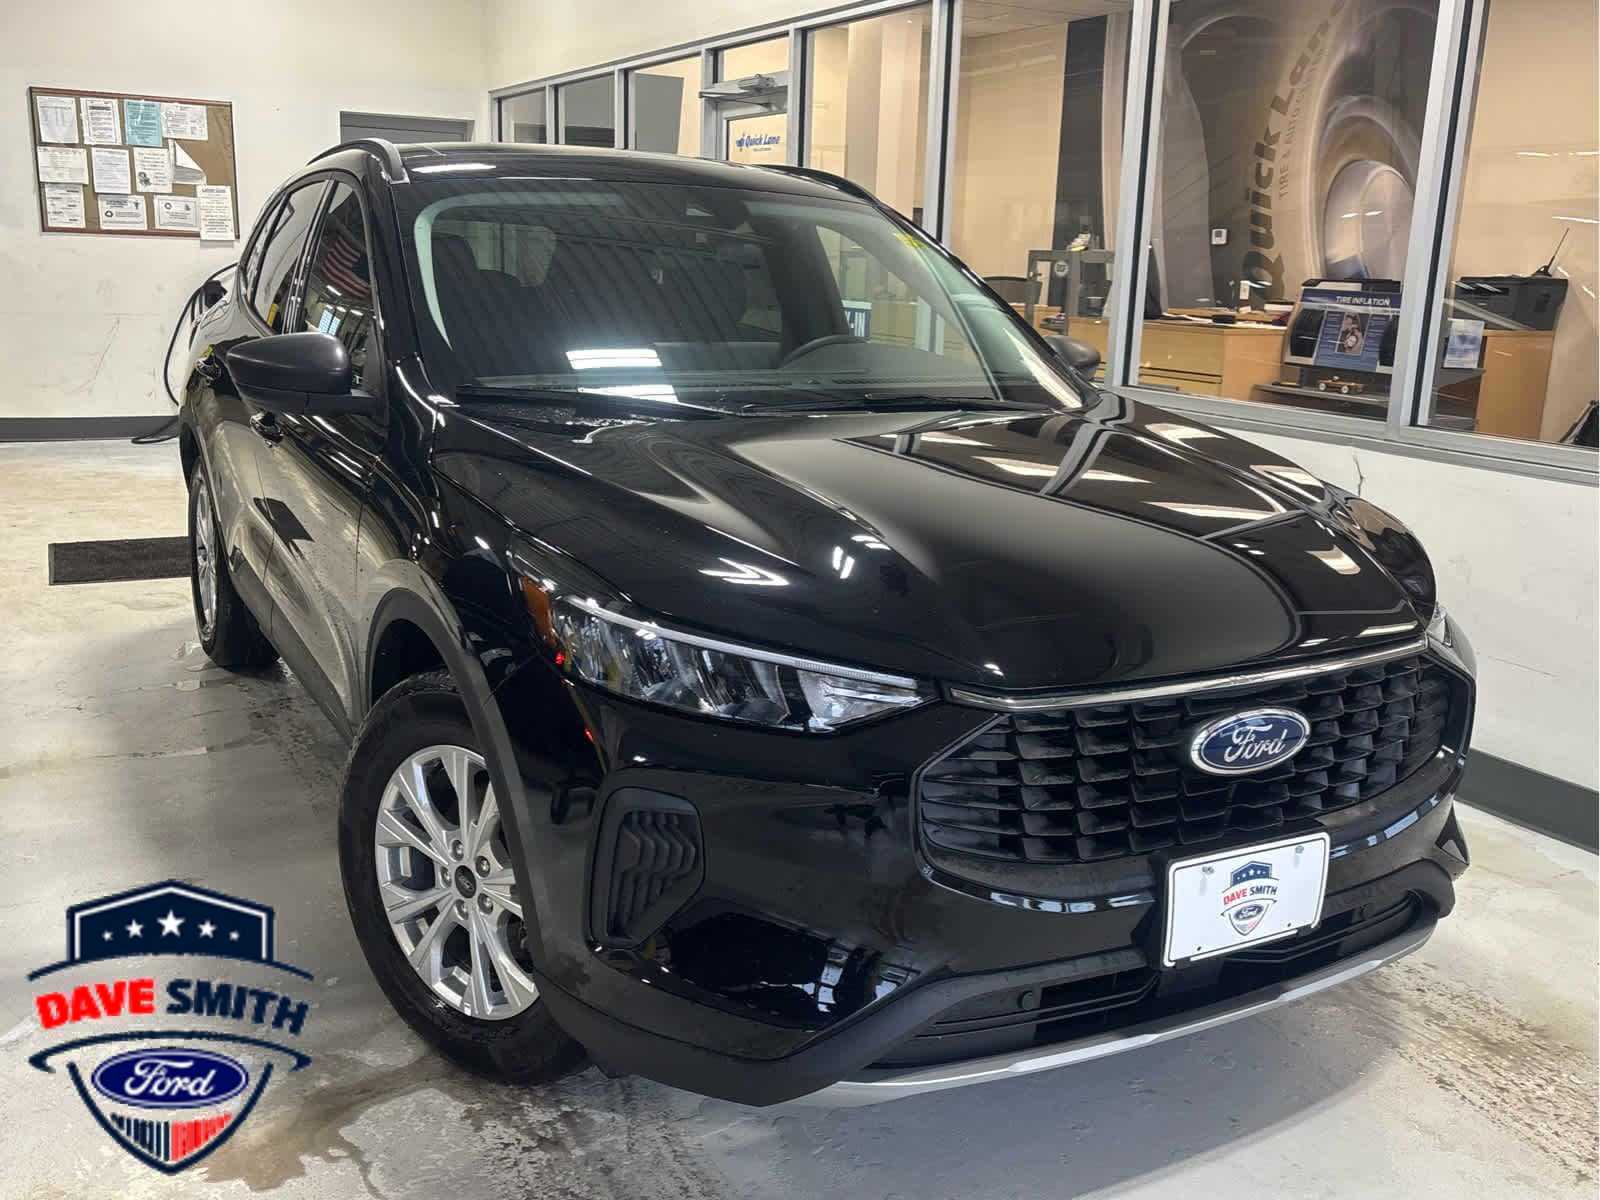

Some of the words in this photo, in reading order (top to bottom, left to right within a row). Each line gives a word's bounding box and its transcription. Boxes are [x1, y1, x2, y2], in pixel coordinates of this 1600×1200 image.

[745, 134, 763, 148] Quick
[763, 134, 780, 145] Lane
[1279, 161, 1289, 200] TIRE
[1336, 295, 1352, 305] TIRE
[1352, 296, 1390, 306] INFLATION
[1223, 723, 1287, 763] Ford
[1223, 887, 1248, 905] DAVE
[1249, 885, 1278, 896] SMITH
